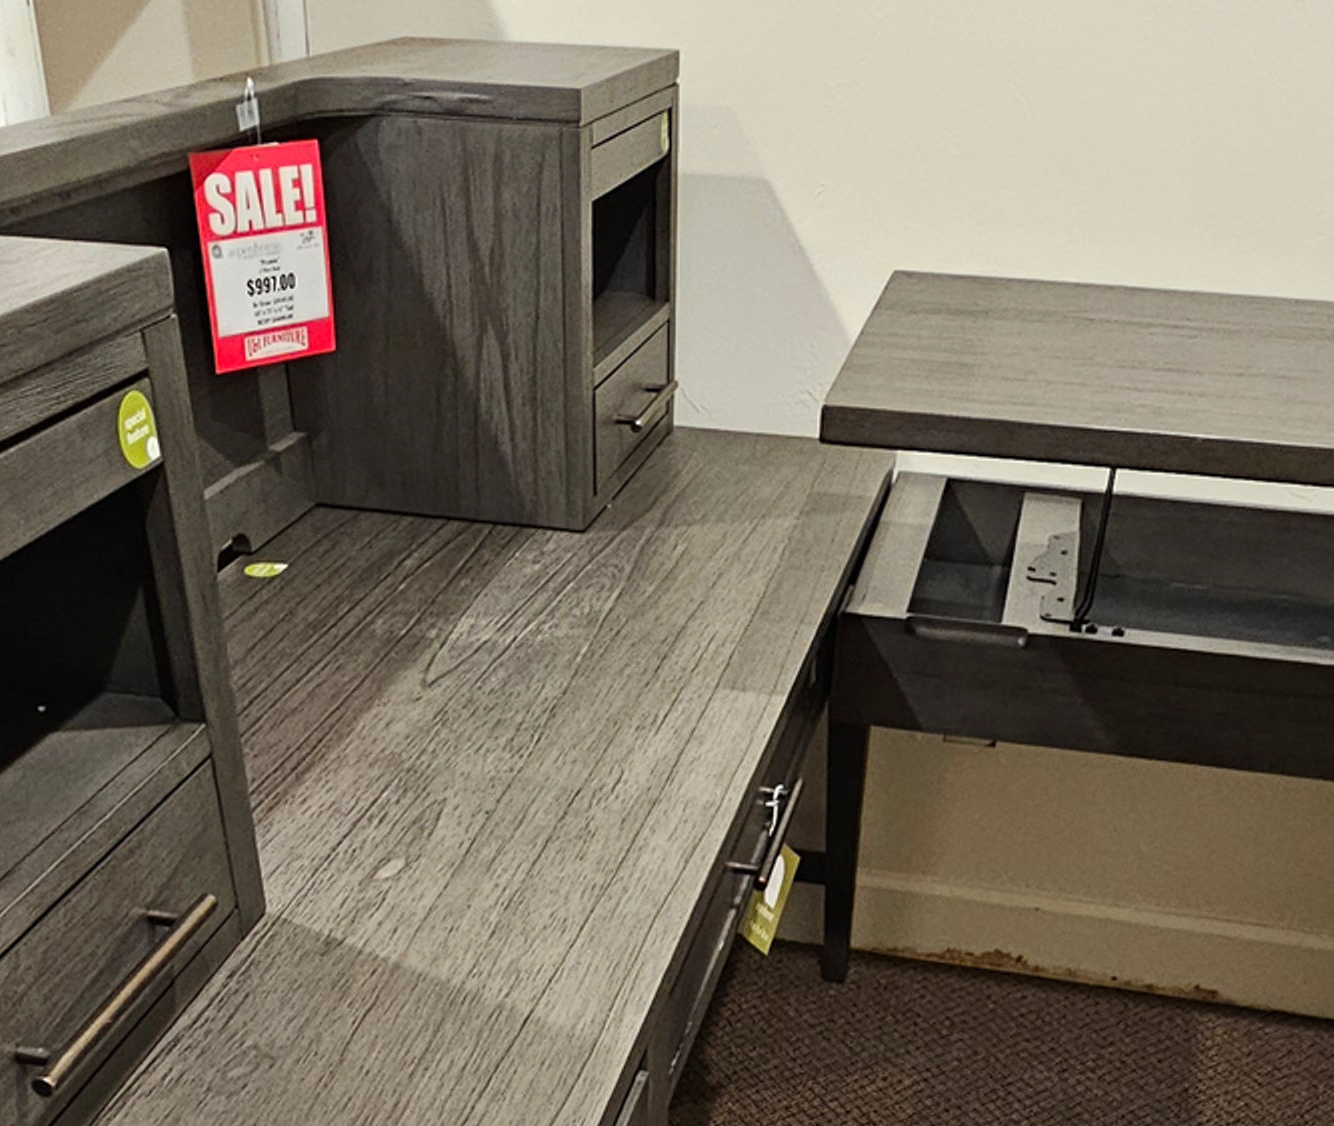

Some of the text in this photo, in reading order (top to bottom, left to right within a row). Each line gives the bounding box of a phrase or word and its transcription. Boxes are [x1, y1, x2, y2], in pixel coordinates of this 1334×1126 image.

[204, 163, 318, 236] SALE!
[247, 272, 297, 297] $997.00
[262, 328, 306, 347] FURNITURE
